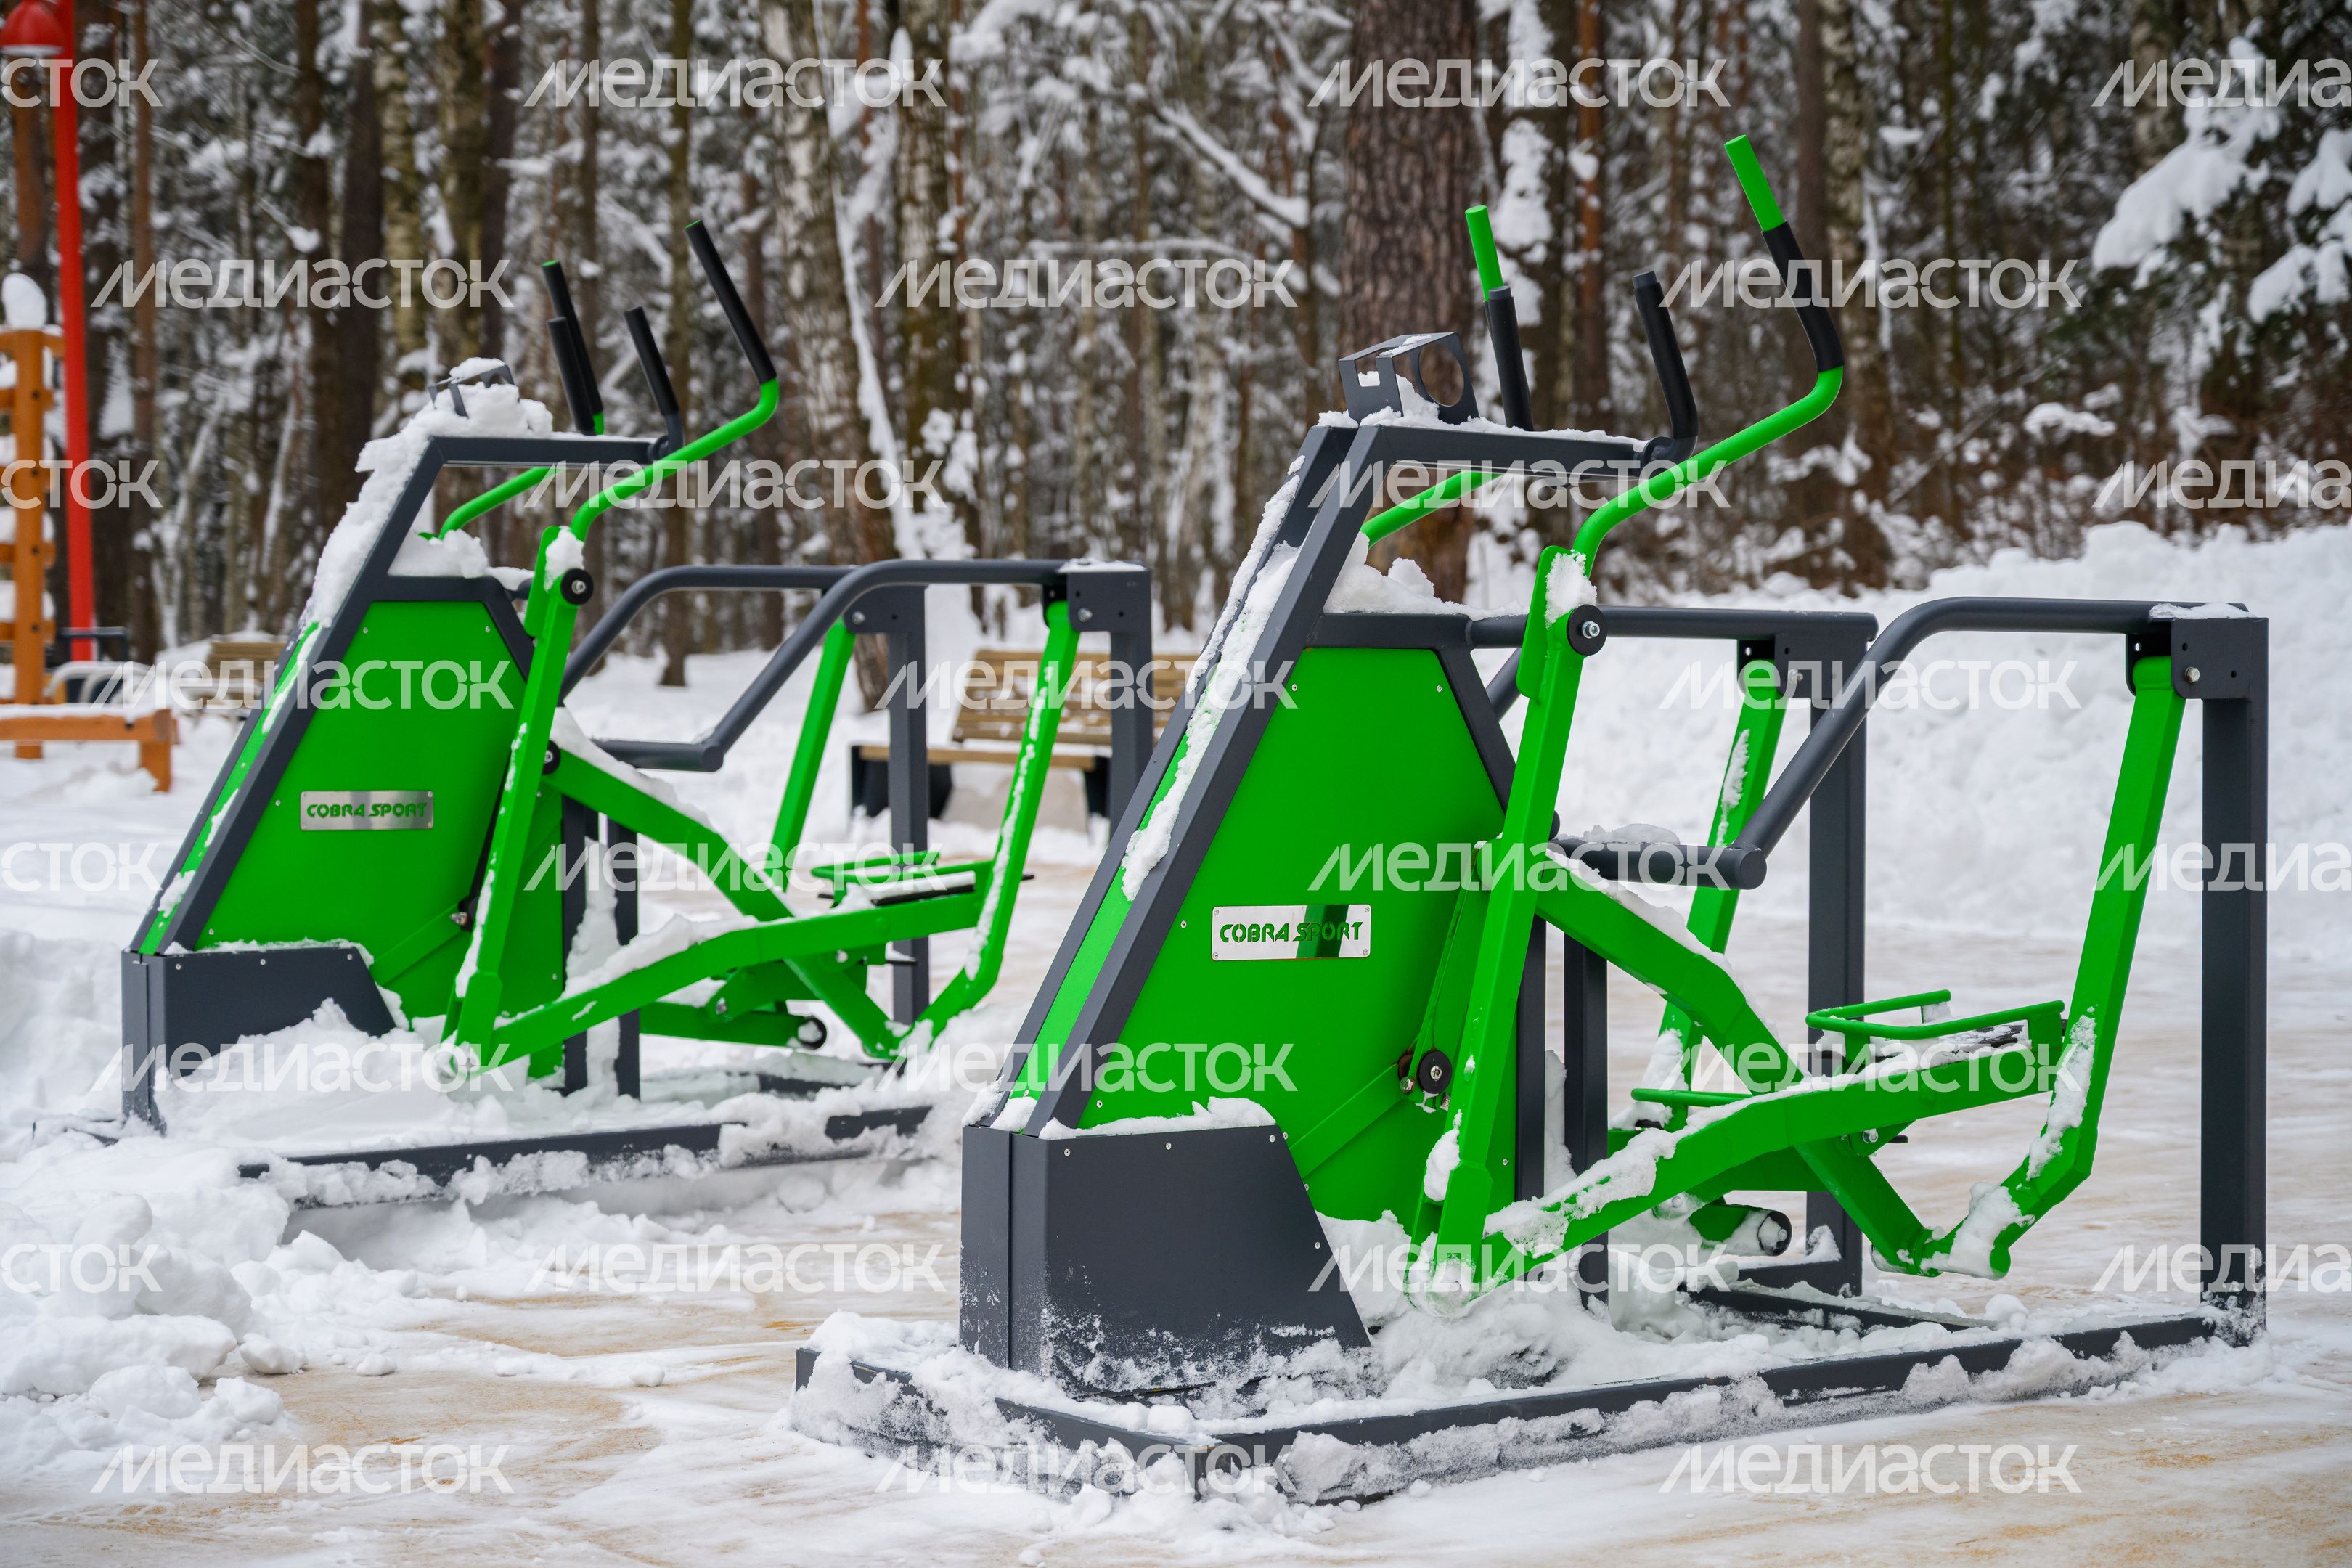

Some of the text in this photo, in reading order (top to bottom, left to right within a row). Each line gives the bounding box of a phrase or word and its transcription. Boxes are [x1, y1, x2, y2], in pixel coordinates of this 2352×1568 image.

[306, 803, 427, 819] COBRA SPORT
[1220, 921, 1363, 943] COBRA SPORT
